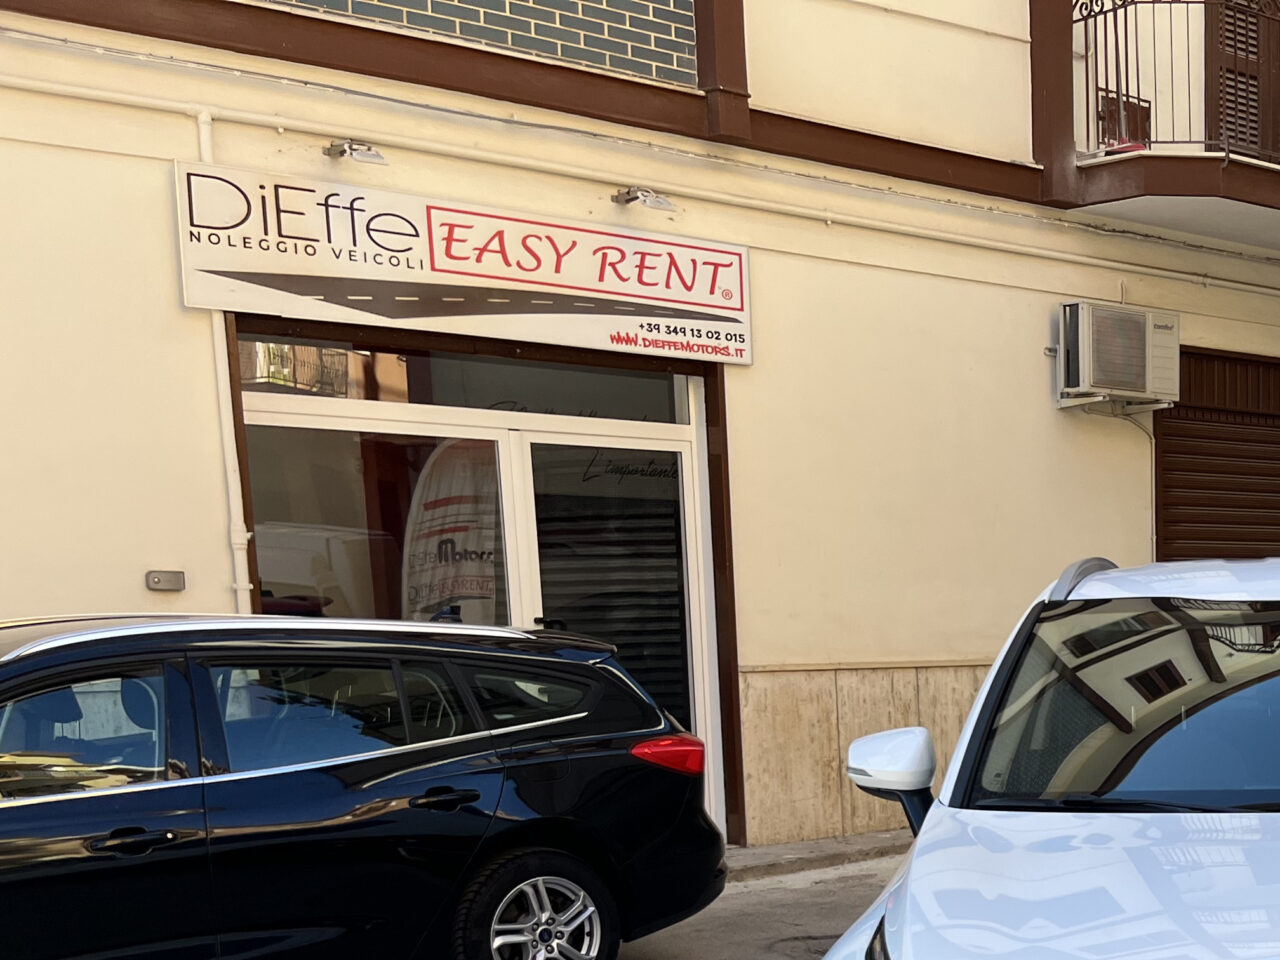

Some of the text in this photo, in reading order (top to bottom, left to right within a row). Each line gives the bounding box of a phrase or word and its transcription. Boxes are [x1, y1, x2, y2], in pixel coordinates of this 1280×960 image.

[187, 172, 420, 253] DiEffe
[189, 230, 424, 270] NOLEGGIO VEICOLI
[439, 222, 578, 274] EASY
[639, 322, 746, 344] +39 349 13 02 015
